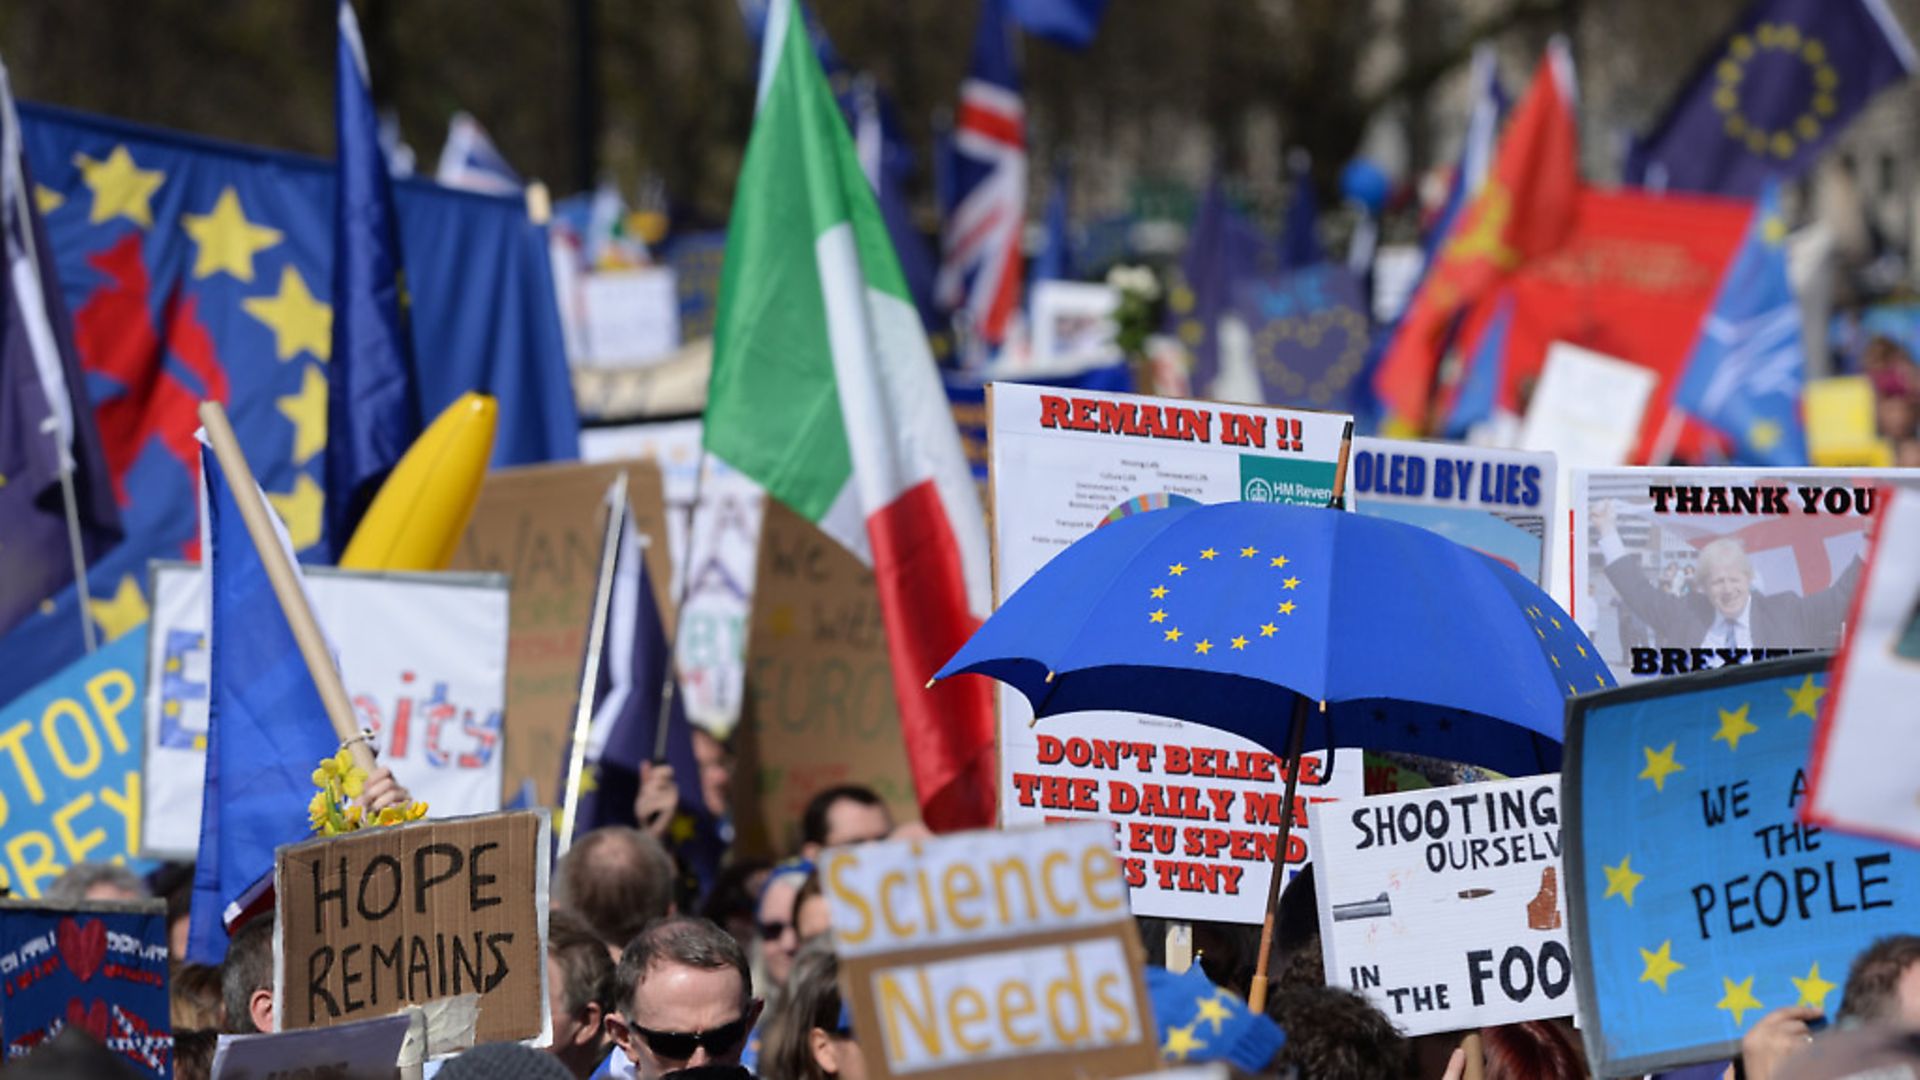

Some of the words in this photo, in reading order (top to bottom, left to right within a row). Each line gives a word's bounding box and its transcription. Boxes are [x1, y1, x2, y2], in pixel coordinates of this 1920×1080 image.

[1040, 395, 1211, 443] REMAIN
[1220, 412, 1267, 449] IN
[1276, 418, 1304, 452] !!
[1273, 481, 1294, 497] HM
[1354, 450, 1426, 497] OLED
[1433, 457, 1474, 501] BY
[1480, 462, 1541, 508] LIES
[1649, 486, 1790, 515] THANK
[1798, 487, 1876, 515] YOU
[0, 669, 136, 828] TOP
[1036, 734, 1157, 773] DON'T
[1163, 744, 1322, 787] BELIEVE
[1013, 773, 1099, 812] THE
[1108, 781, 1236, 823] DAILY
[1243, 790, 1342, 829] MA
[1351, 786, 1558, 850] SHOOTING
[1701, 780, 1750, 828] WE
[1129, 822, 1177, 855] EU
[1183, 826, 1308, 864] SPEND
[1754, 819, 1822, 860] THE
[312, 842, 502, 935] HOPE
[826, 840, 1123, 946] Science
[1153, 859, 1244, 895] TINY
[1691, 853, 1894, 940] PEOPLE
[307, 930, 514, 1024] REMAINS
[877, 945, 1133, 1063] Needs
[1350, 964, 1381, 991] IN
[1386, 983, 1451, 1015] THE
[1466, 940, 1572, 1007] FOO
